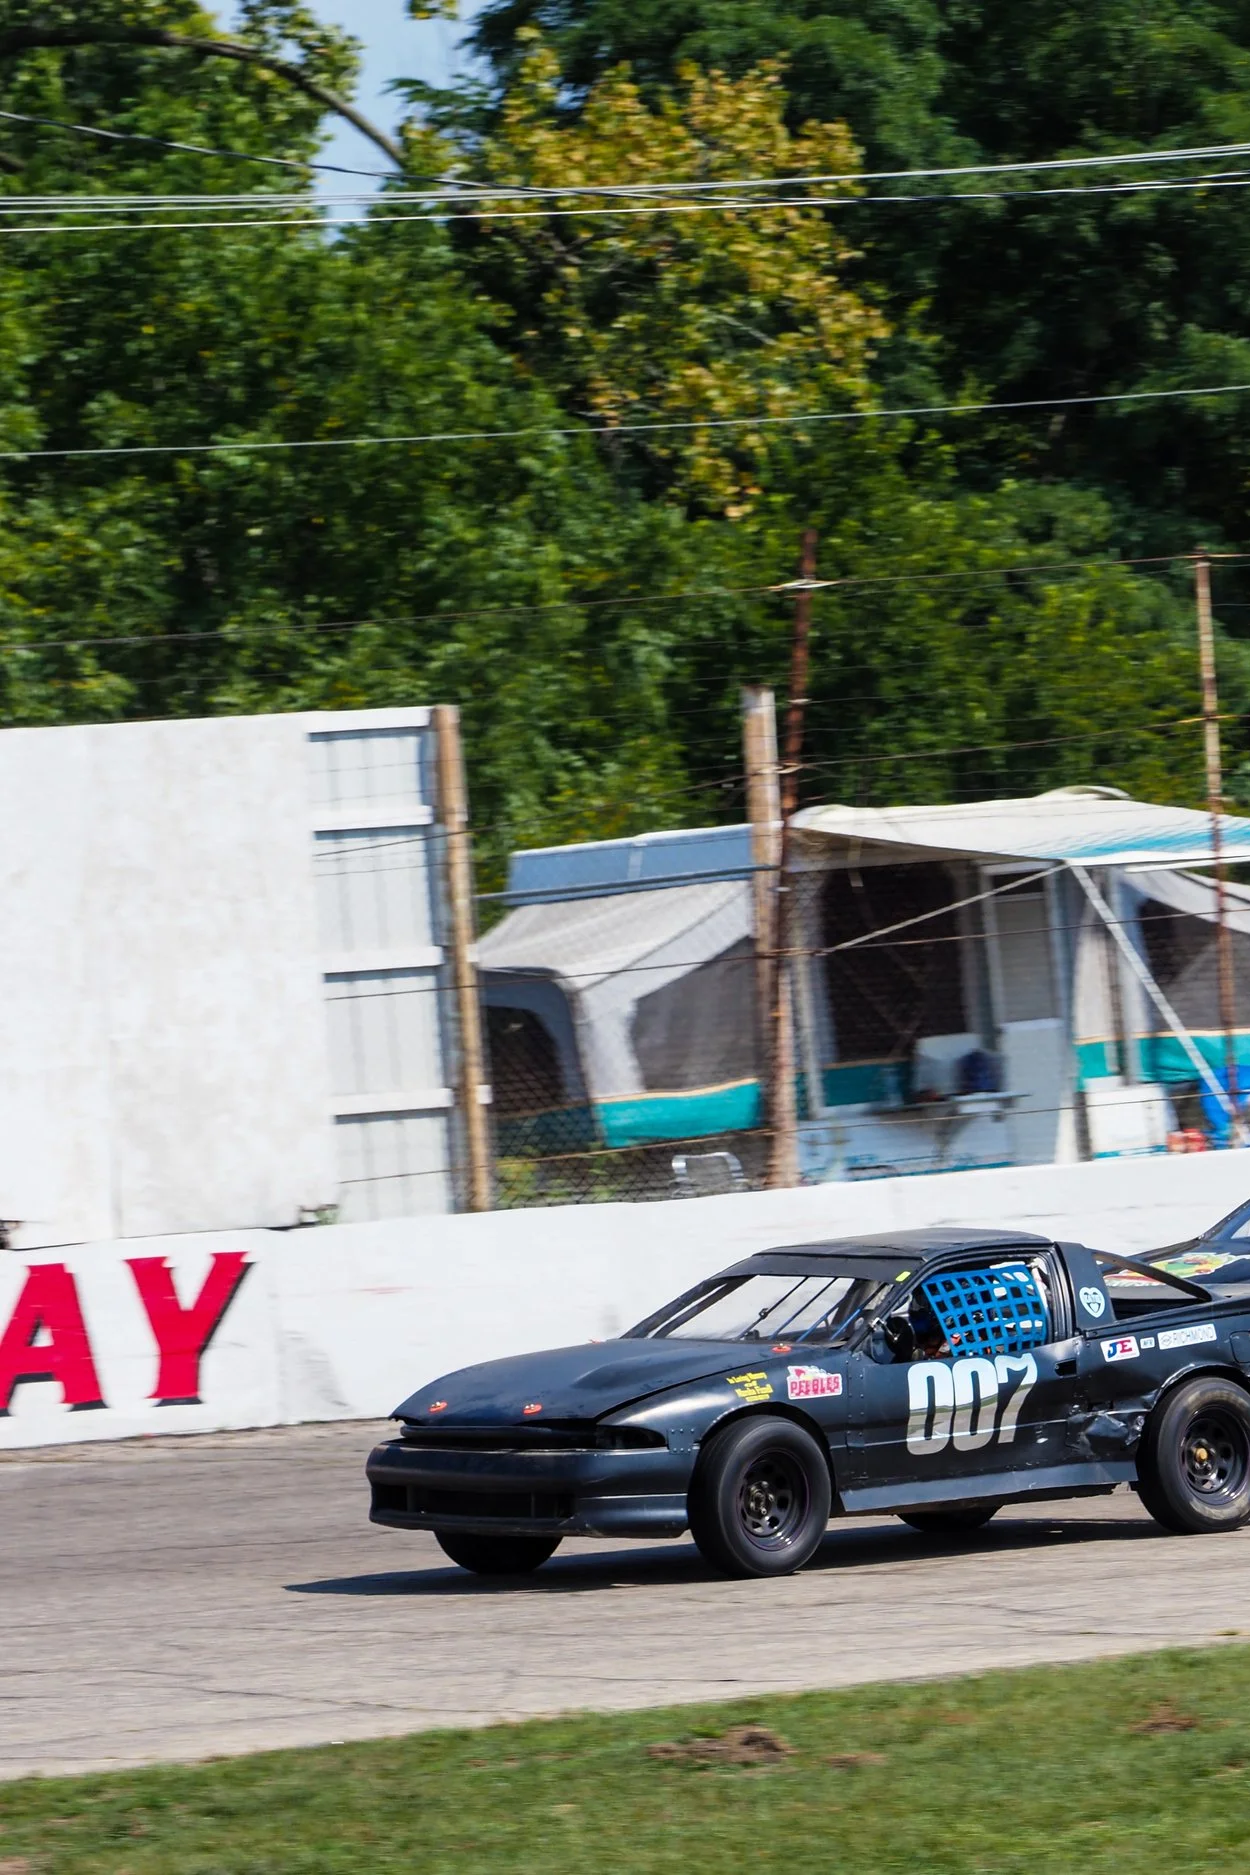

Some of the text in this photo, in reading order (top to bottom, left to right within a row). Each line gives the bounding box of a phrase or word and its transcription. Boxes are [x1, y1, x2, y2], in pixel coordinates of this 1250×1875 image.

[0, 1251, 256, 1418] AY
[1171, 1325, 1215, 1346] RICHMOND
[1107, 1340, 1133, 1358] JE
[790, 1375, 840, 1397] PEEBLES
[907, 1353, 1038, 1456] 007
